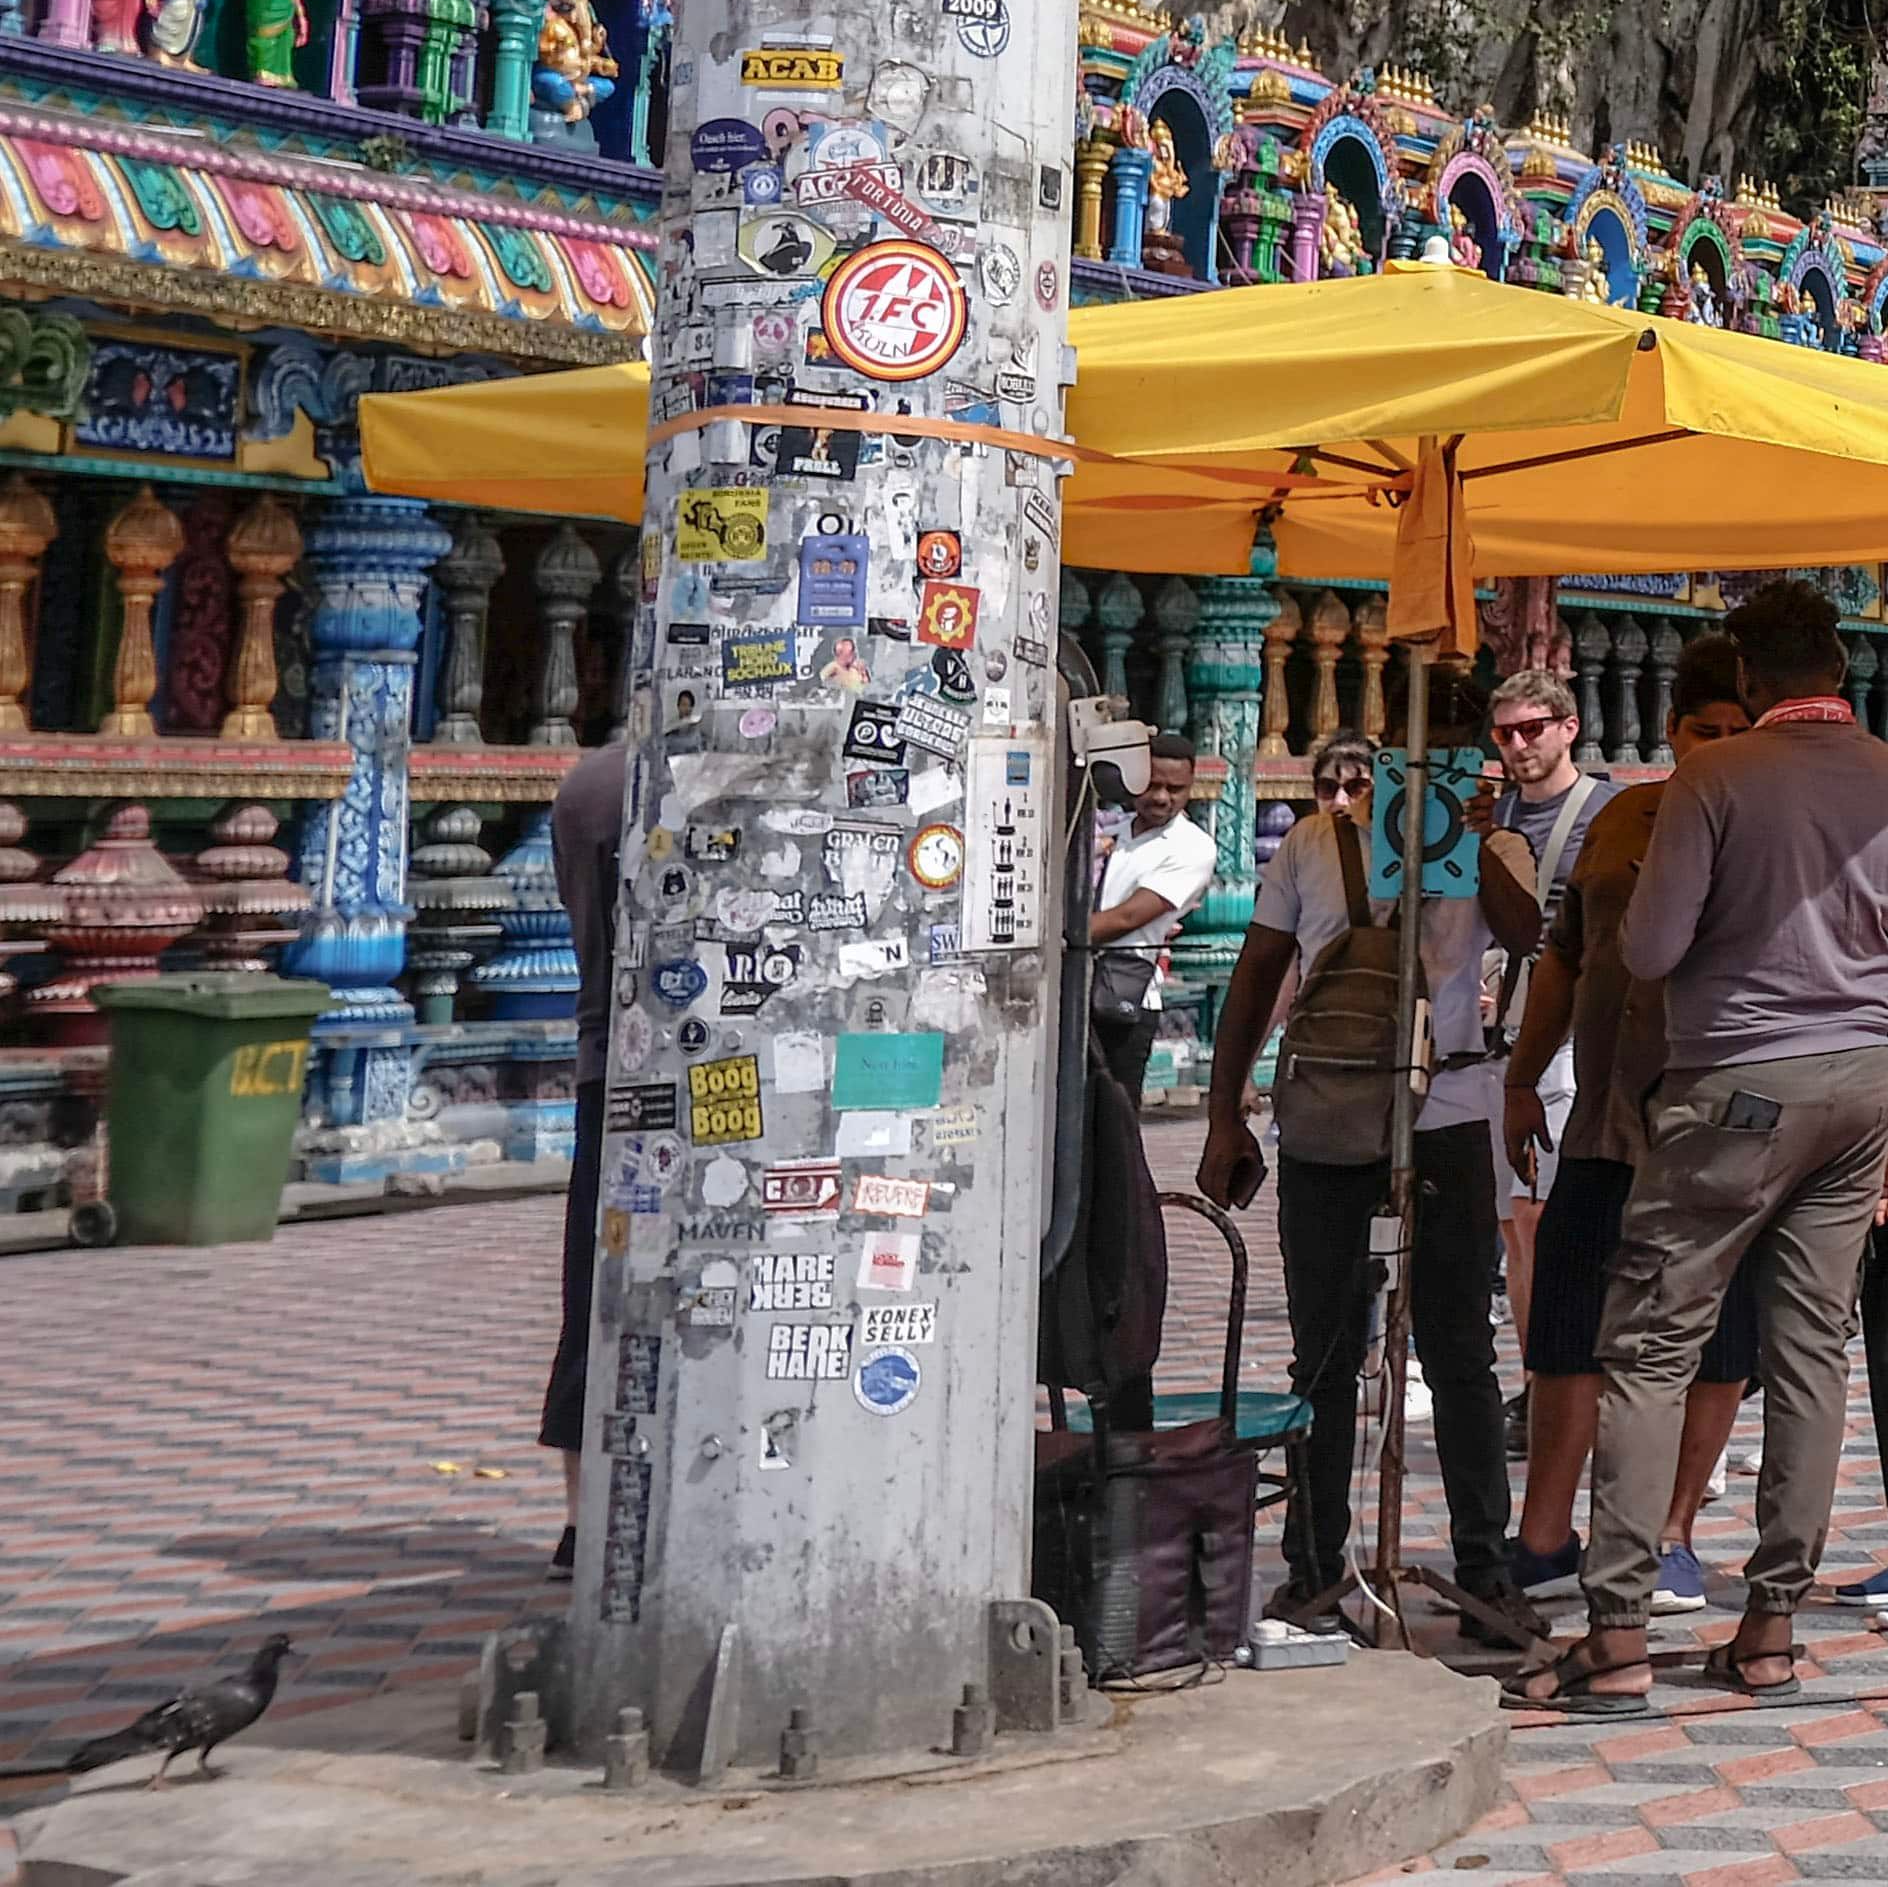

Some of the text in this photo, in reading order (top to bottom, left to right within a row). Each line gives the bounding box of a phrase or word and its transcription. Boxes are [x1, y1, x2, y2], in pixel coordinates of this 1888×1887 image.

[744, 57, 839, 80] ACAB
[690, 1065, 758, 1098] Boog
[692, 1103, 761, 1139] Boog
[867, 1308, 933, 1326] KONEX
[865, 1326, 932, 1342] SELLY
